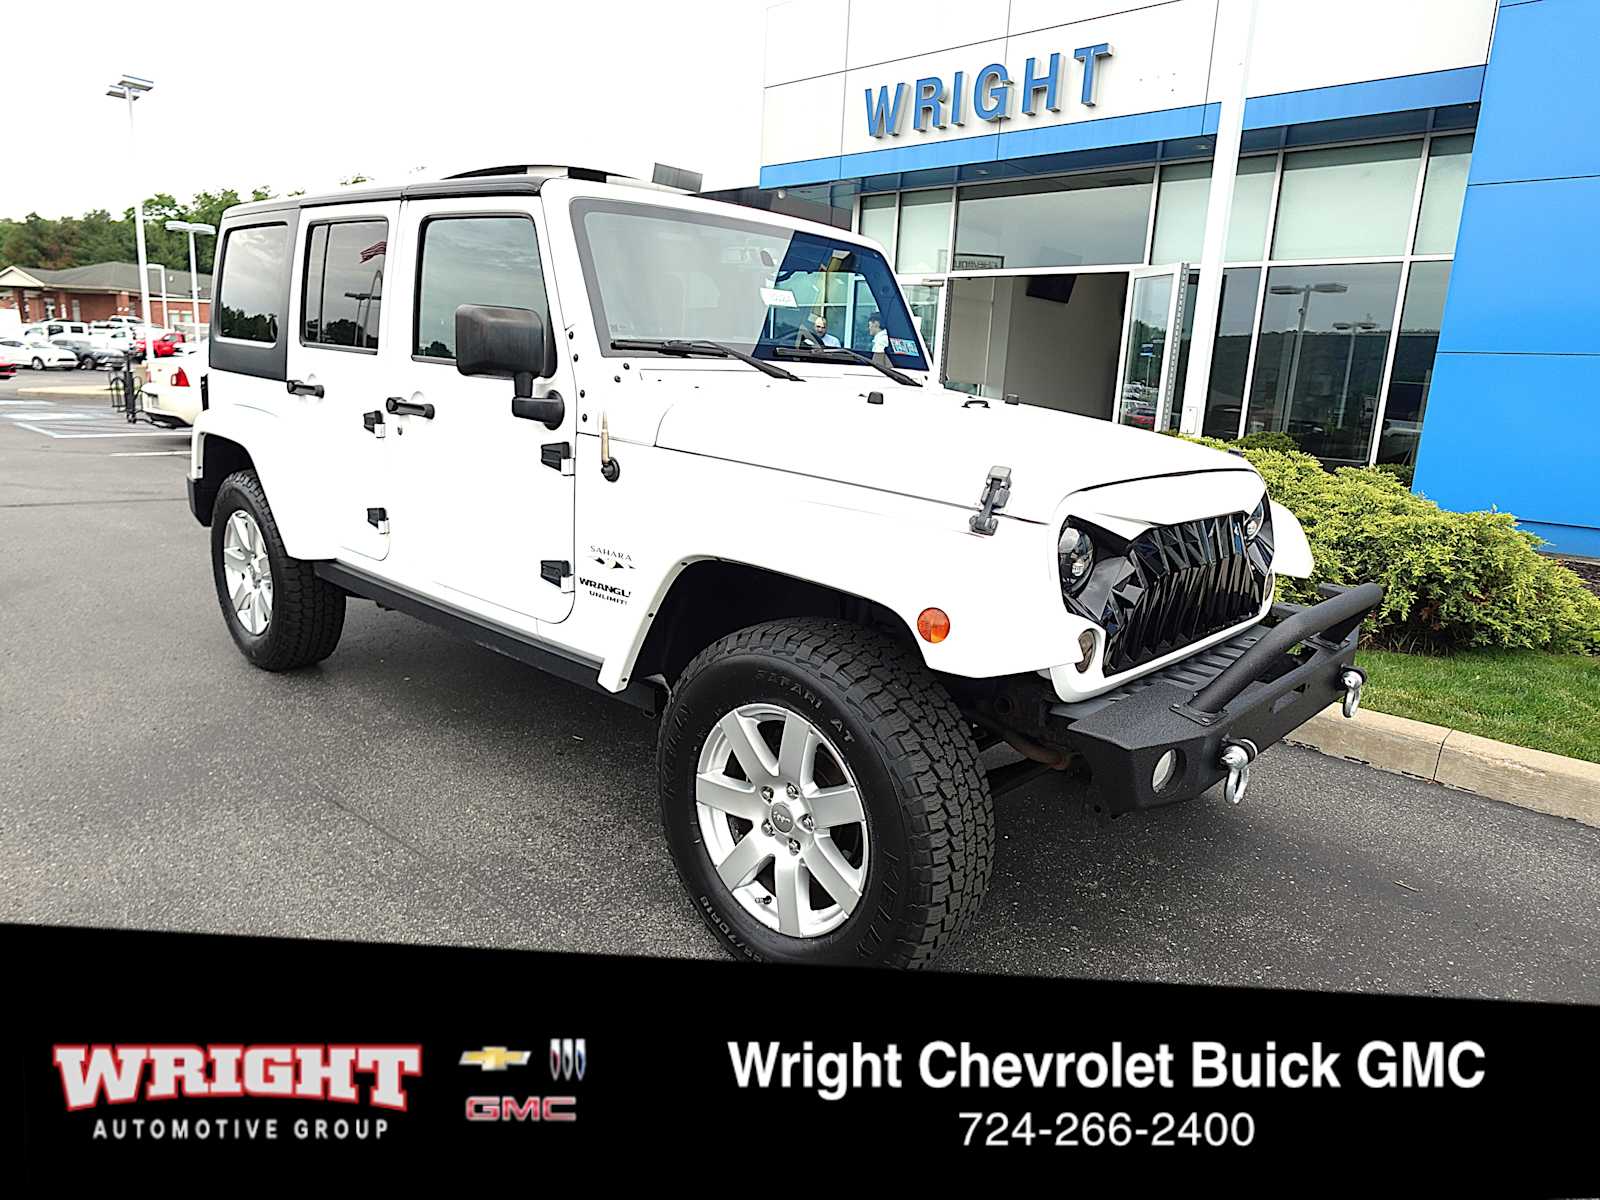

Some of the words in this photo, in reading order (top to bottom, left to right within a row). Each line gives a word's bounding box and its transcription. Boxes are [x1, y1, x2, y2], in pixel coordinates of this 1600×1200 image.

[864, 42, 1114, 138] WRIGHT
[589, 545, 632, 561] SAHARA
[579, 576, 632, 598] WRANGL
[589, 590, 628, 606] UNLIMIT
